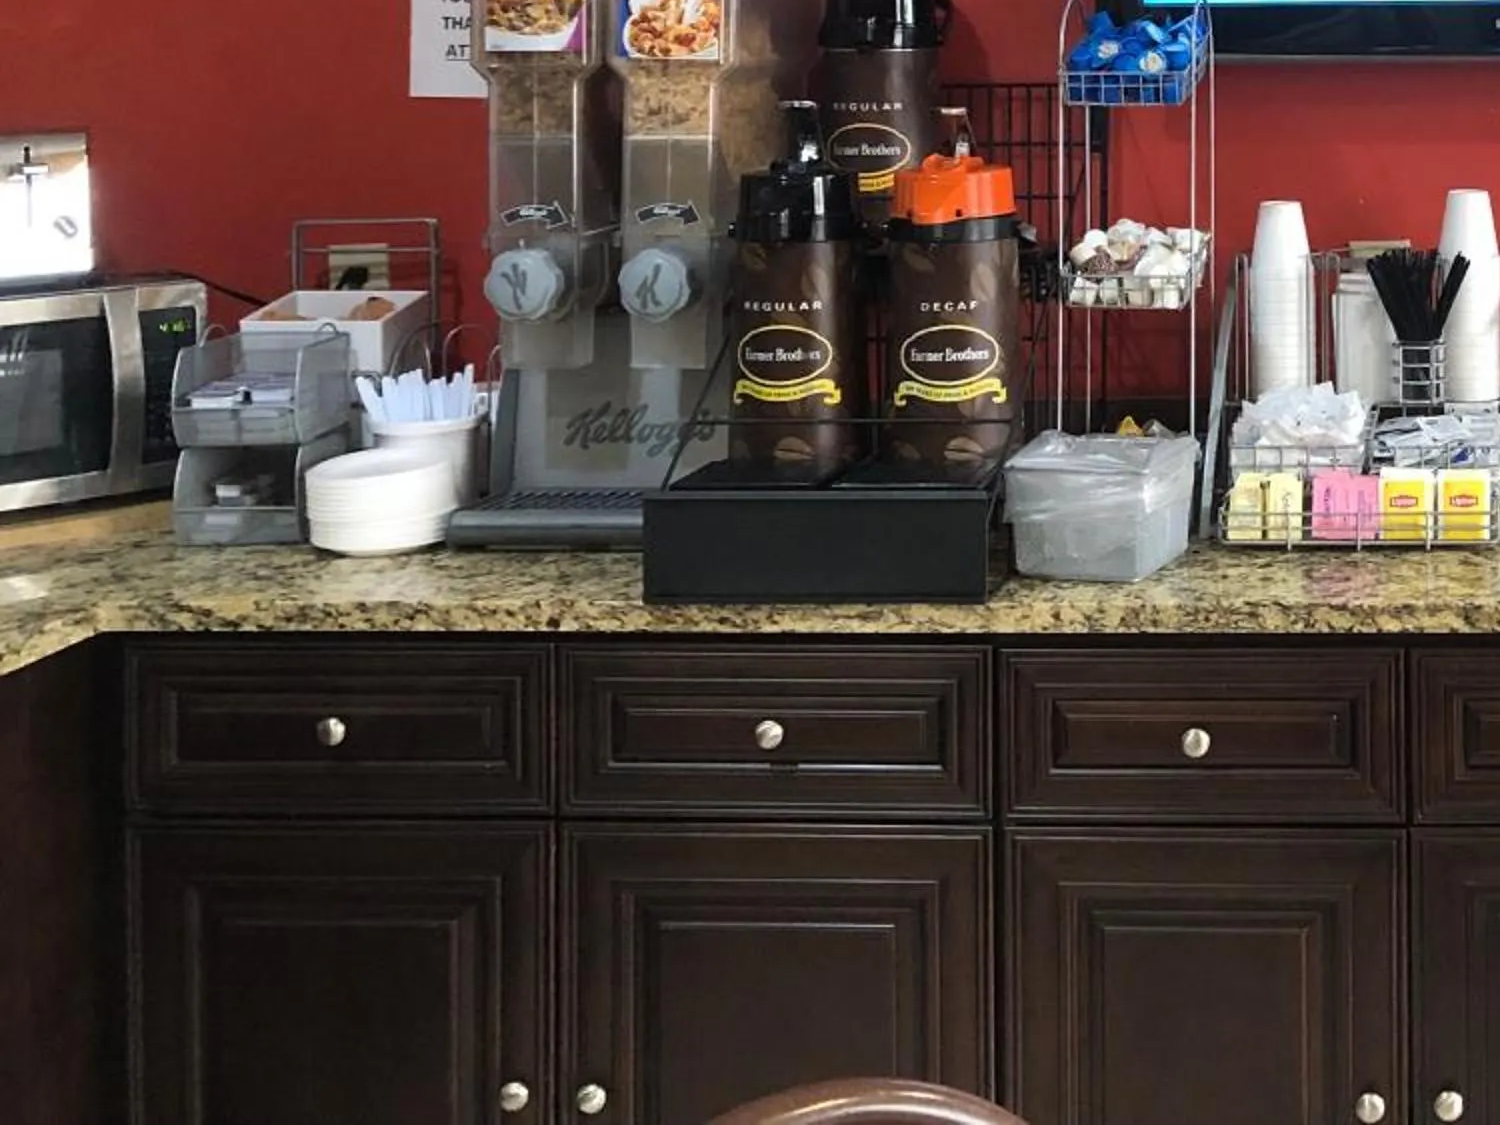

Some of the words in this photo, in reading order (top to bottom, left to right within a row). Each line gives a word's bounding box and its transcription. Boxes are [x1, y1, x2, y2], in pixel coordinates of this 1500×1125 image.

[744, 300, 824, 312] REGULAR
[920, 300, 978, 312] DECAF
[775, 347, 822, 362] Brothrs
[945, 347, 989, 362] Brothers
[563, 400, 715, 457] Kellog's
